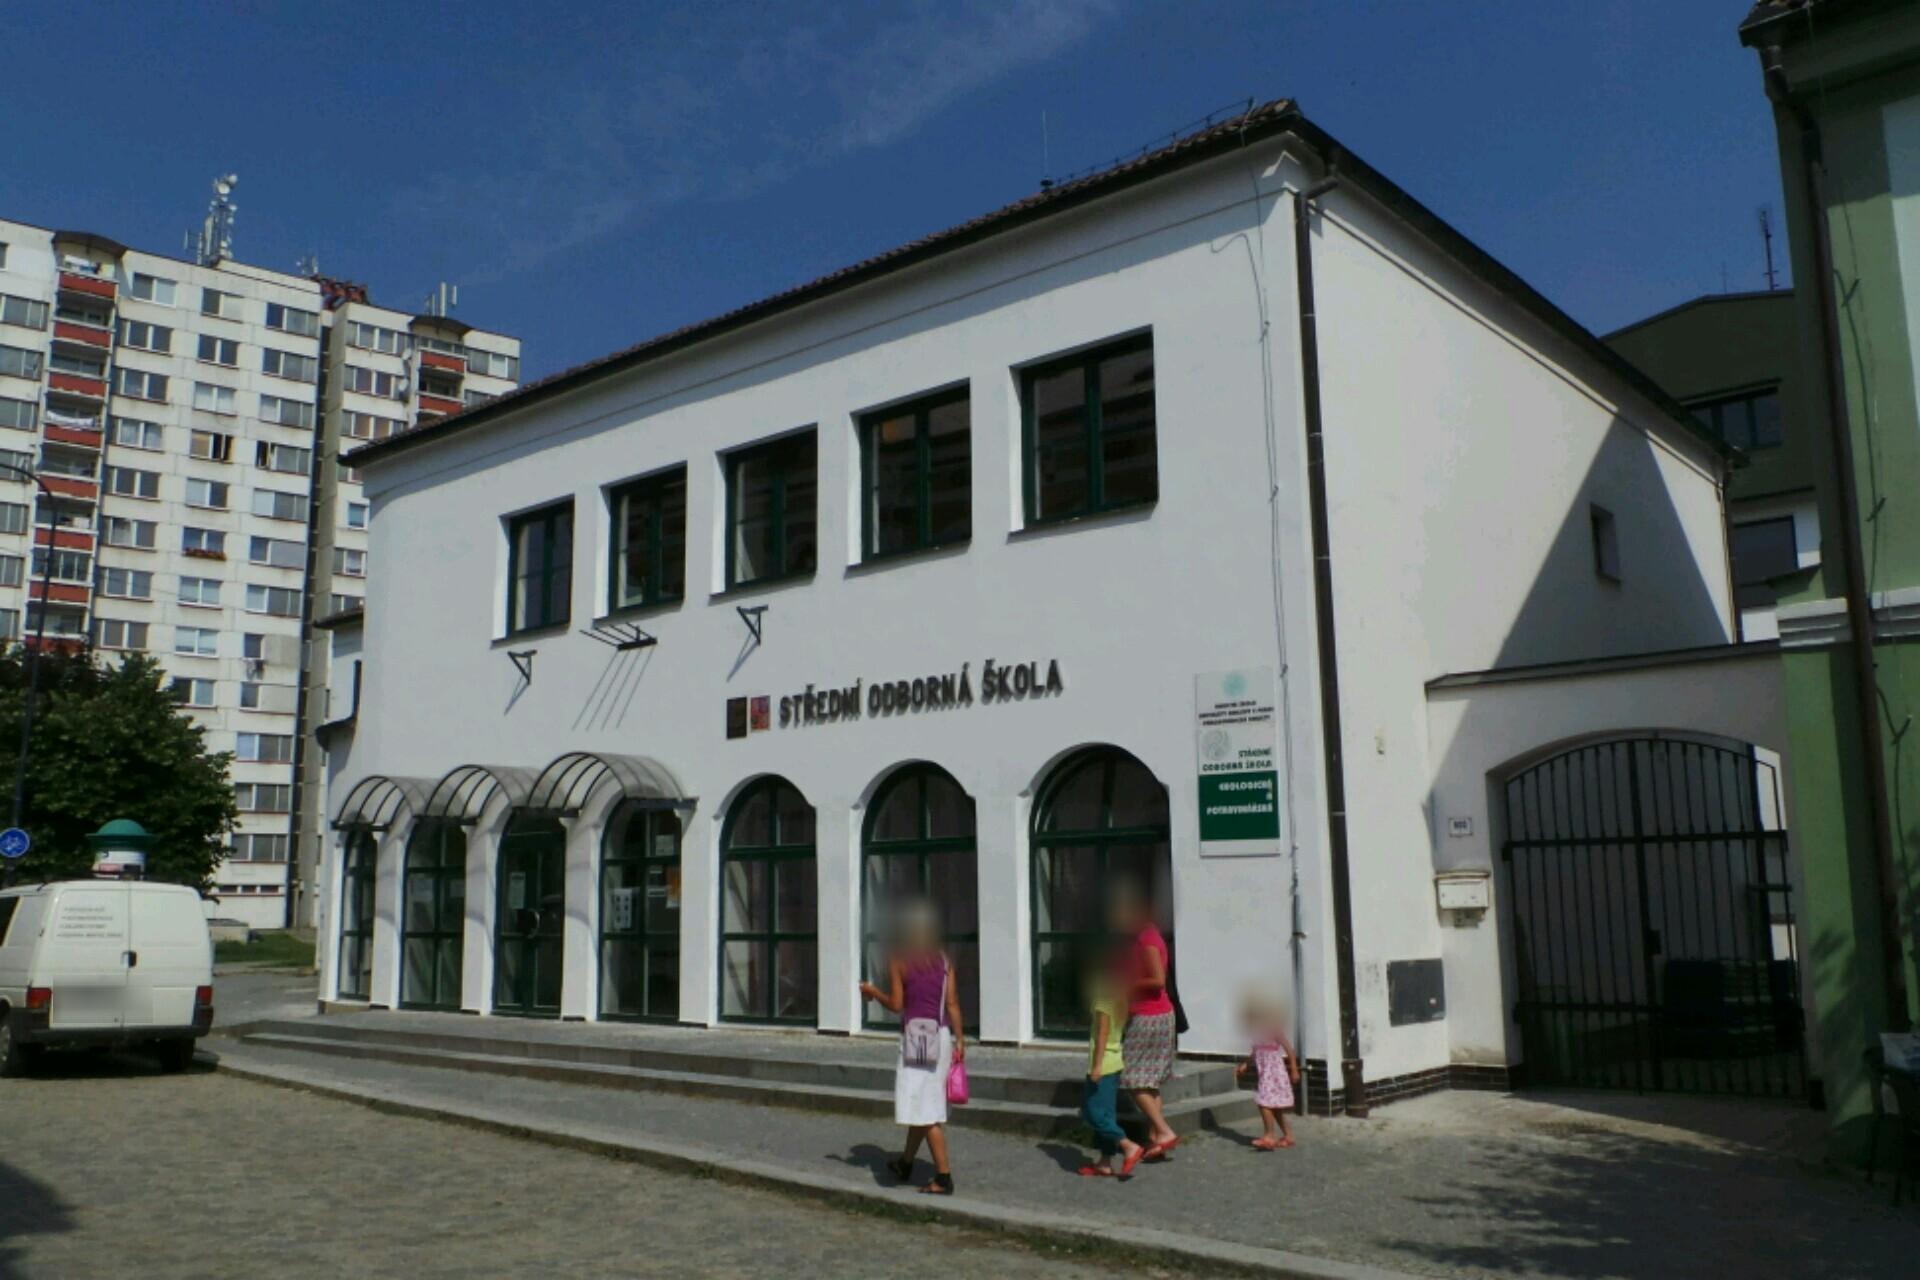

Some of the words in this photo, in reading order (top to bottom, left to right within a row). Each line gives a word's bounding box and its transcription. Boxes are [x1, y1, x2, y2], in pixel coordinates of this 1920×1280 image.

[779, 677, 862, 726] STŘEDNÍ
[868, 662, 973, 716] ODBORNÁ
[982, 659, 1063, 702] ŠKOLA
